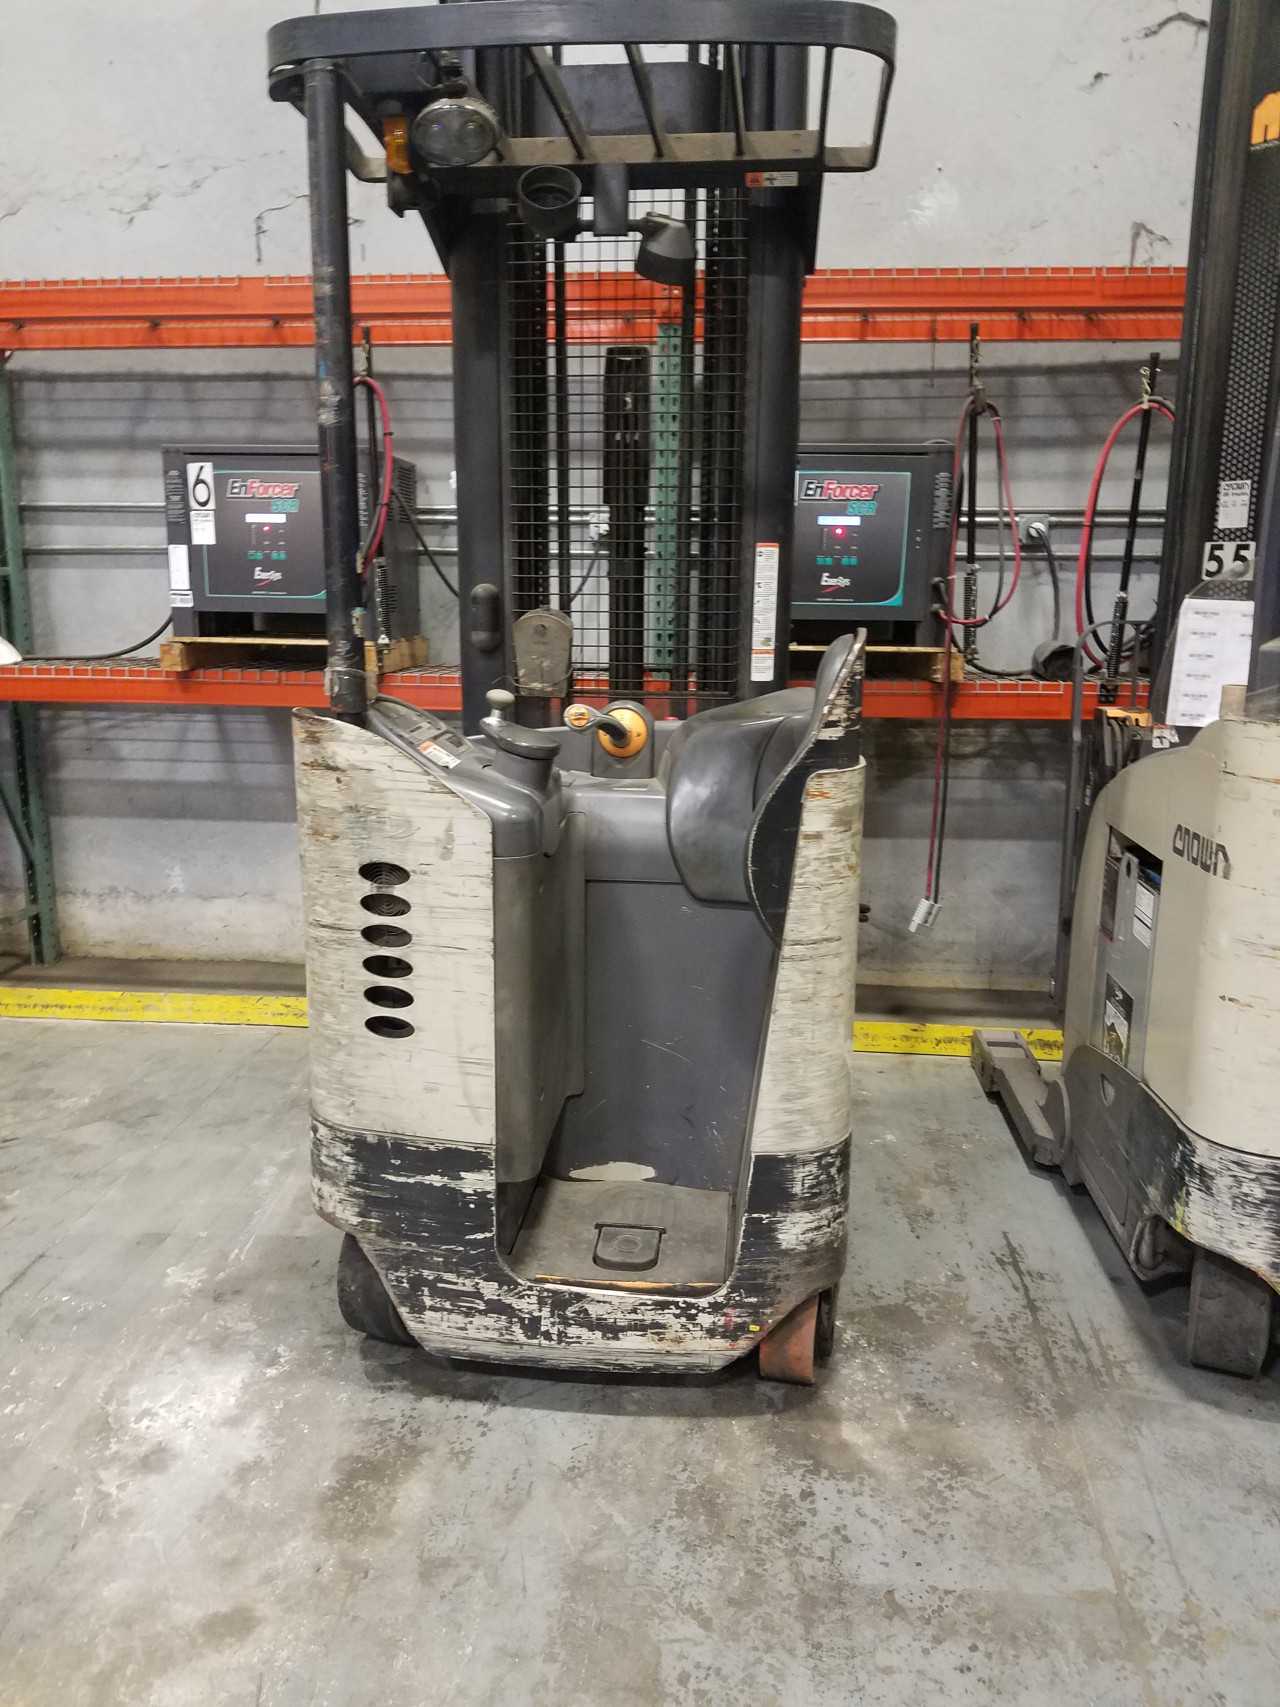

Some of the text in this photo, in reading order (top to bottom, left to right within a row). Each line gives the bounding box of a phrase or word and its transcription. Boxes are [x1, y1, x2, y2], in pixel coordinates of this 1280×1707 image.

[193, 465, 211, 507] 6
[227, 479, 299, 498] EnForcer
[801, 480, 879, 500] EnForcer
[1205, 544, 1250, 578] 55
[1172, 823, 1231, 881] CROWN
